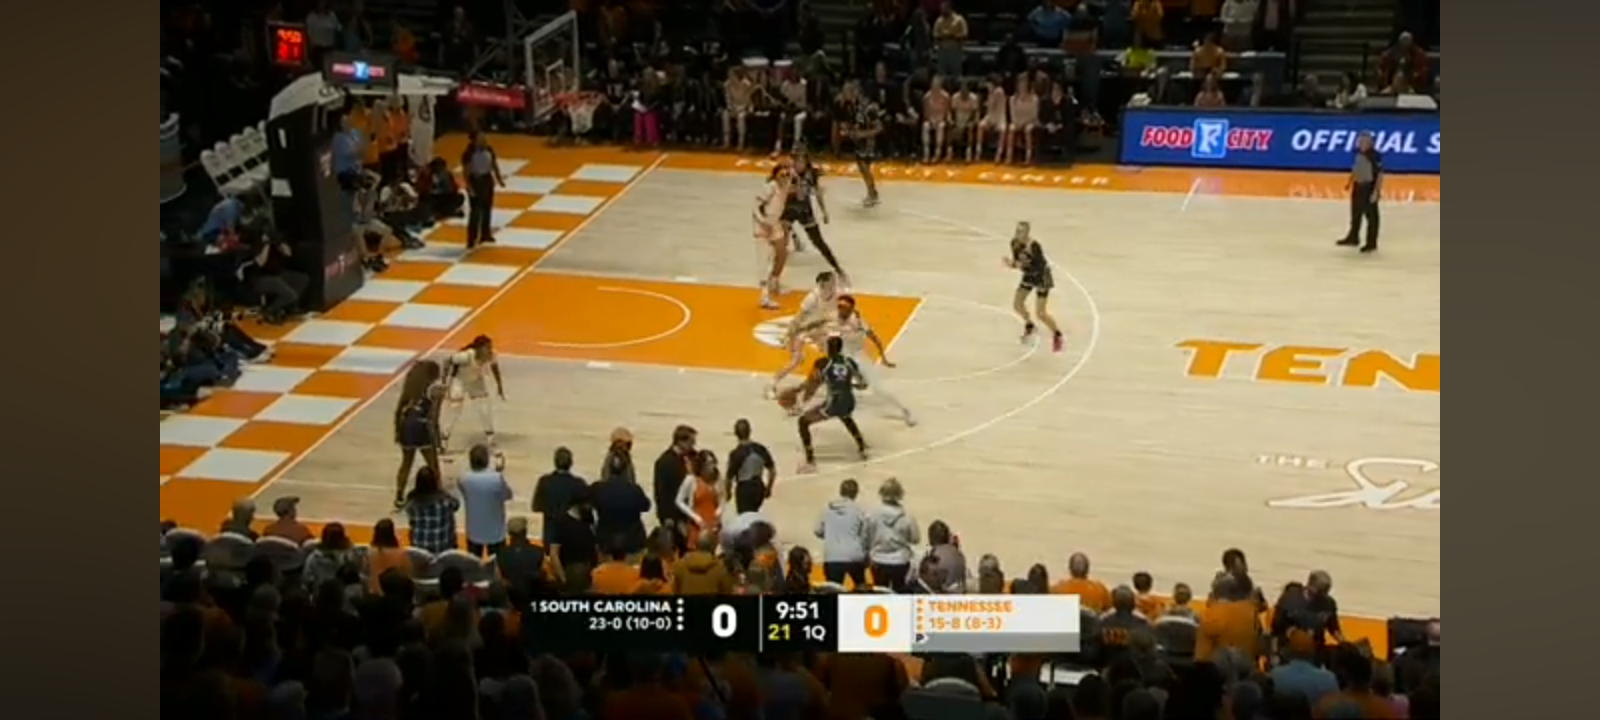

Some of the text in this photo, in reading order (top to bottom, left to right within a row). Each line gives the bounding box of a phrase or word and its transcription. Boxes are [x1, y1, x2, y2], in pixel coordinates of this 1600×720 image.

[1140, 125, 1193, 148] FOOD
[1227, 127, 1272, 150] CITY
[1291, 129, 1418, 153] OFFIIAL
